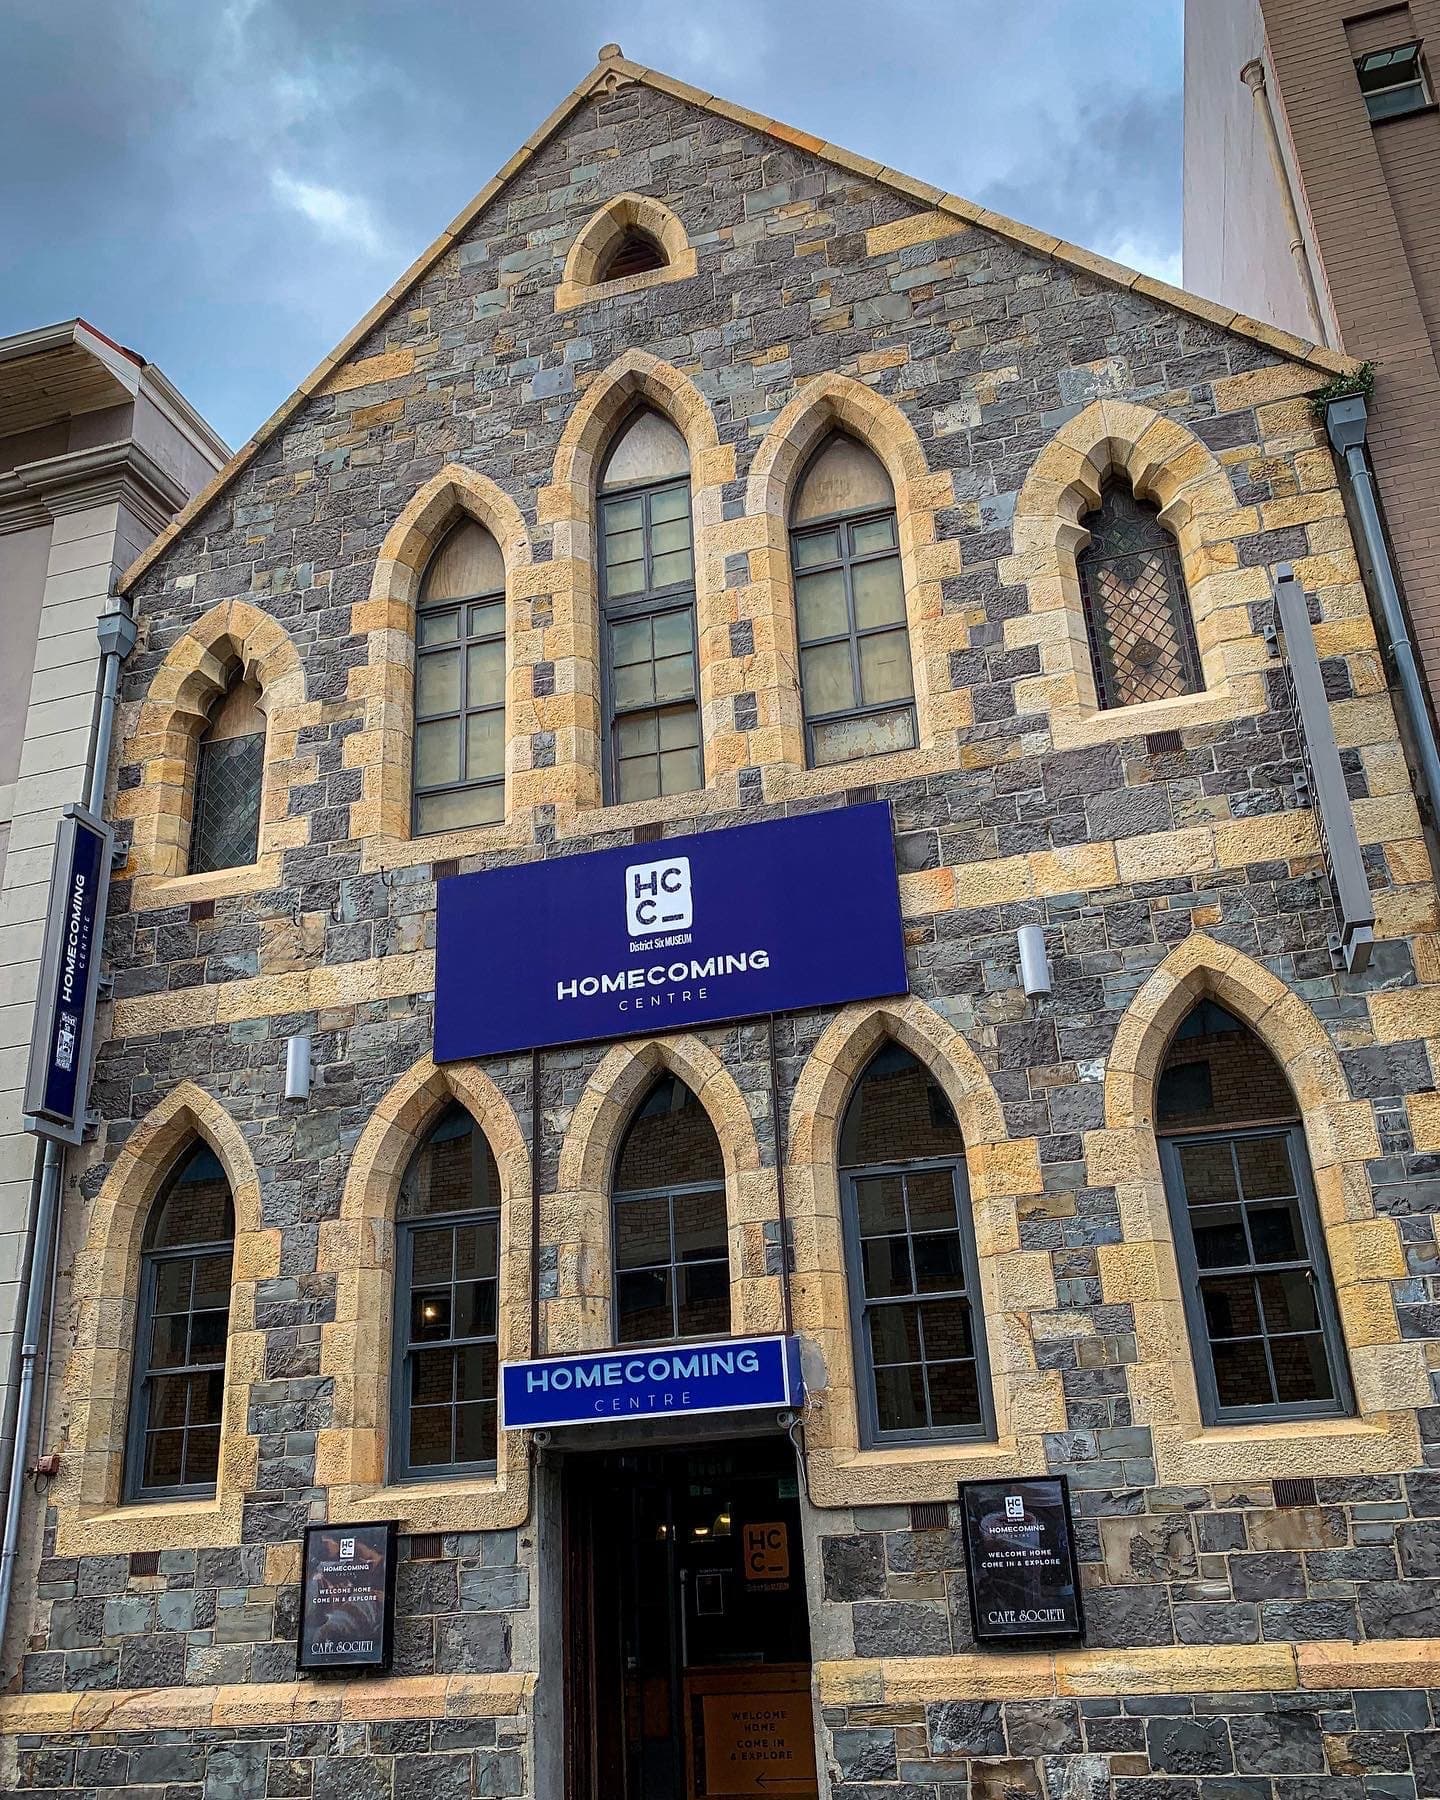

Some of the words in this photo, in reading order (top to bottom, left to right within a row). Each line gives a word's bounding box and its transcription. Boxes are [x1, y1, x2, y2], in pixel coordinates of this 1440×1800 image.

[635, 868, 682, 898] HC
[62, 874, 86, 1002] HOMECOMING
[79, 915, 91, 969] CENTRE
[629, 939, 654, 953] District
[654, 937, 665, 949] Six
[665, 933, 692, 947] MUSEUM
[557, 950, 770, 1001] HOMECOMING
[619, 988, 708, 1011] CENTRE
[526, 1350, 759, 1393] HOMECOMING
[594, 1391, 691, 1412] CENTRE
[989, 1524, 1045, 1534] HOMECOMING
[749, 1529, 782, 1550] HC
[988, 1550, 1026, 1558] WELCOME
[323, 1564, 370, 1572] HOMECOMING
[731, 1711, 786, 1720] WELCOME
[744, 1723, 776, 1731] HOME
[736, 1740, 769, 1748] COME
[773, 1739, 785, 1747] IN
[741, 1751, 793, 1760] EXPLORE
